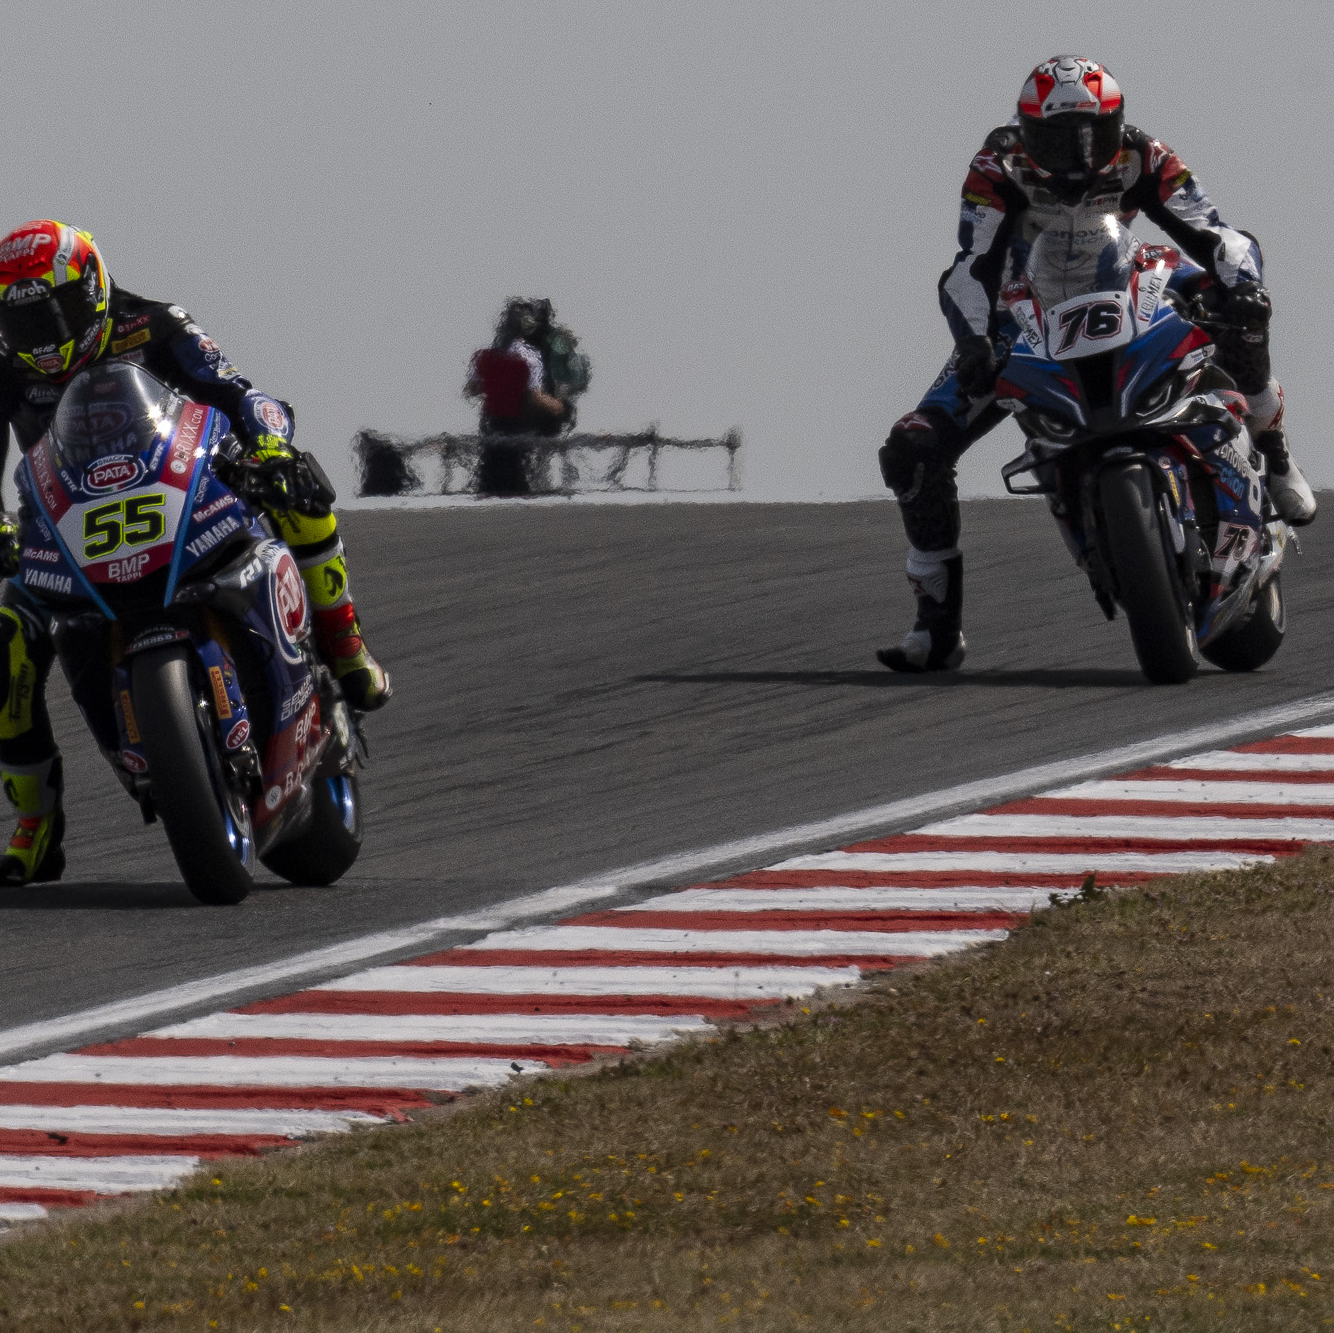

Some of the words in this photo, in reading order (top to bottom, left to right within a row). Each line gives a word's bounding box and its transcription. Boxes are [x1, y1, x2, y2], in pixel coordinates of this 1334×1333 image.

[8, 280, 47, 301] Airoh
[1055, 300, 1123, 356] 76
[98, 455, 127, 466] SNACK
[94, 465, 130, 484] PATA
[193, 494, 235, 523] McAMS
[84, 493, 165, 560] 55
[185, 516, 240, 558] YAMAHA
[23, 547, 61, 563] McAMS
[108, 553, 151, 579] BMP
[24, 568, 73, 595] YAMAHA
[115, 571, 143, 584] TAPPI
[231, 726, 249, 745] HEL
